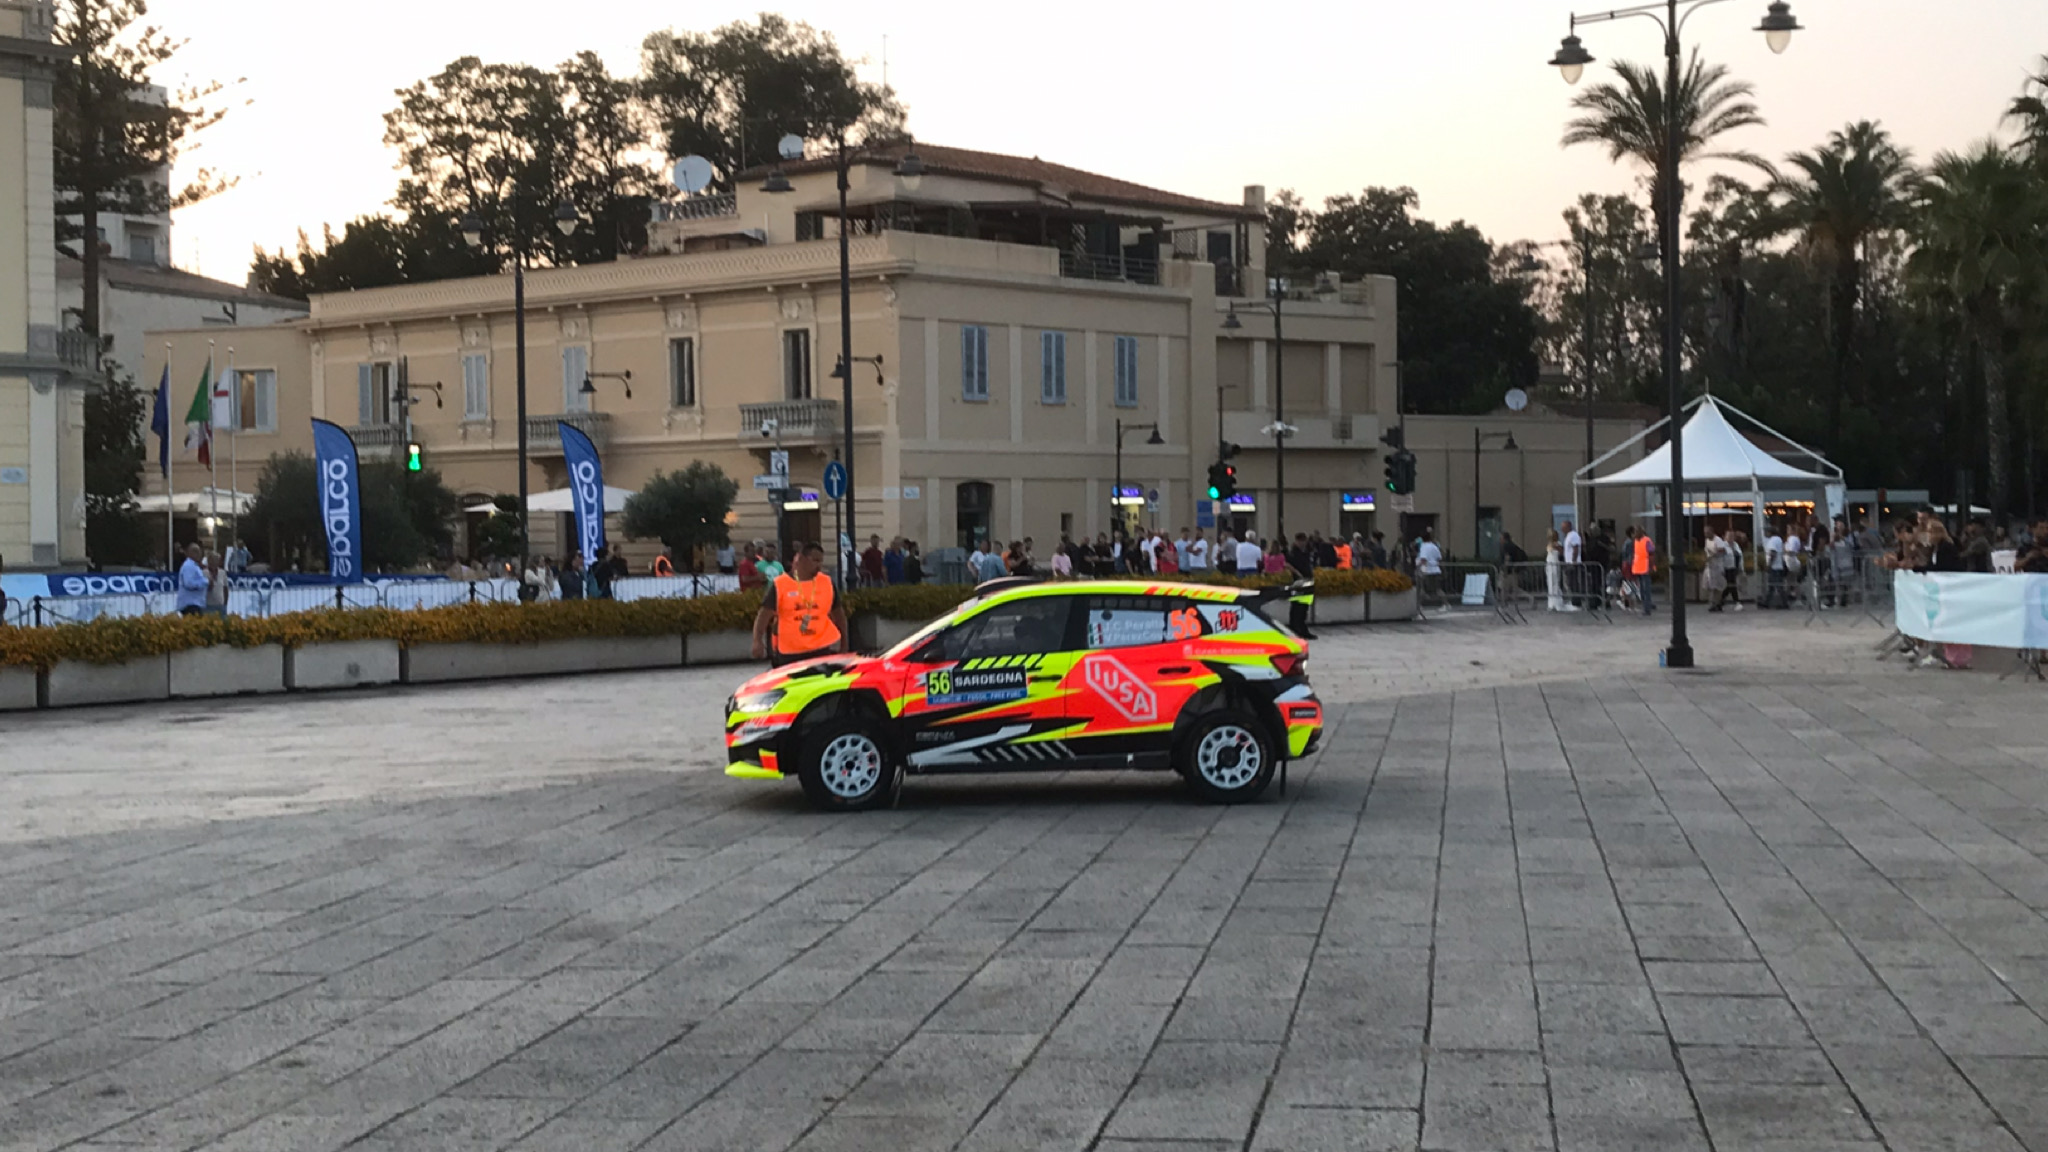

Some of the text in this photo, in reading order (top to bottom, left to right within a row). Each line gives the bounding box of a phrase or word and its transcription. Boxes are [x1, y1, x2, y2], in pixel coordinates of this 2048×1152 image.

[1170, 607, 1201, 640] 56
[929, 671, 1023, 695] 56 SARDEGNA
[1094, 663, 1150, 714] IUSA
